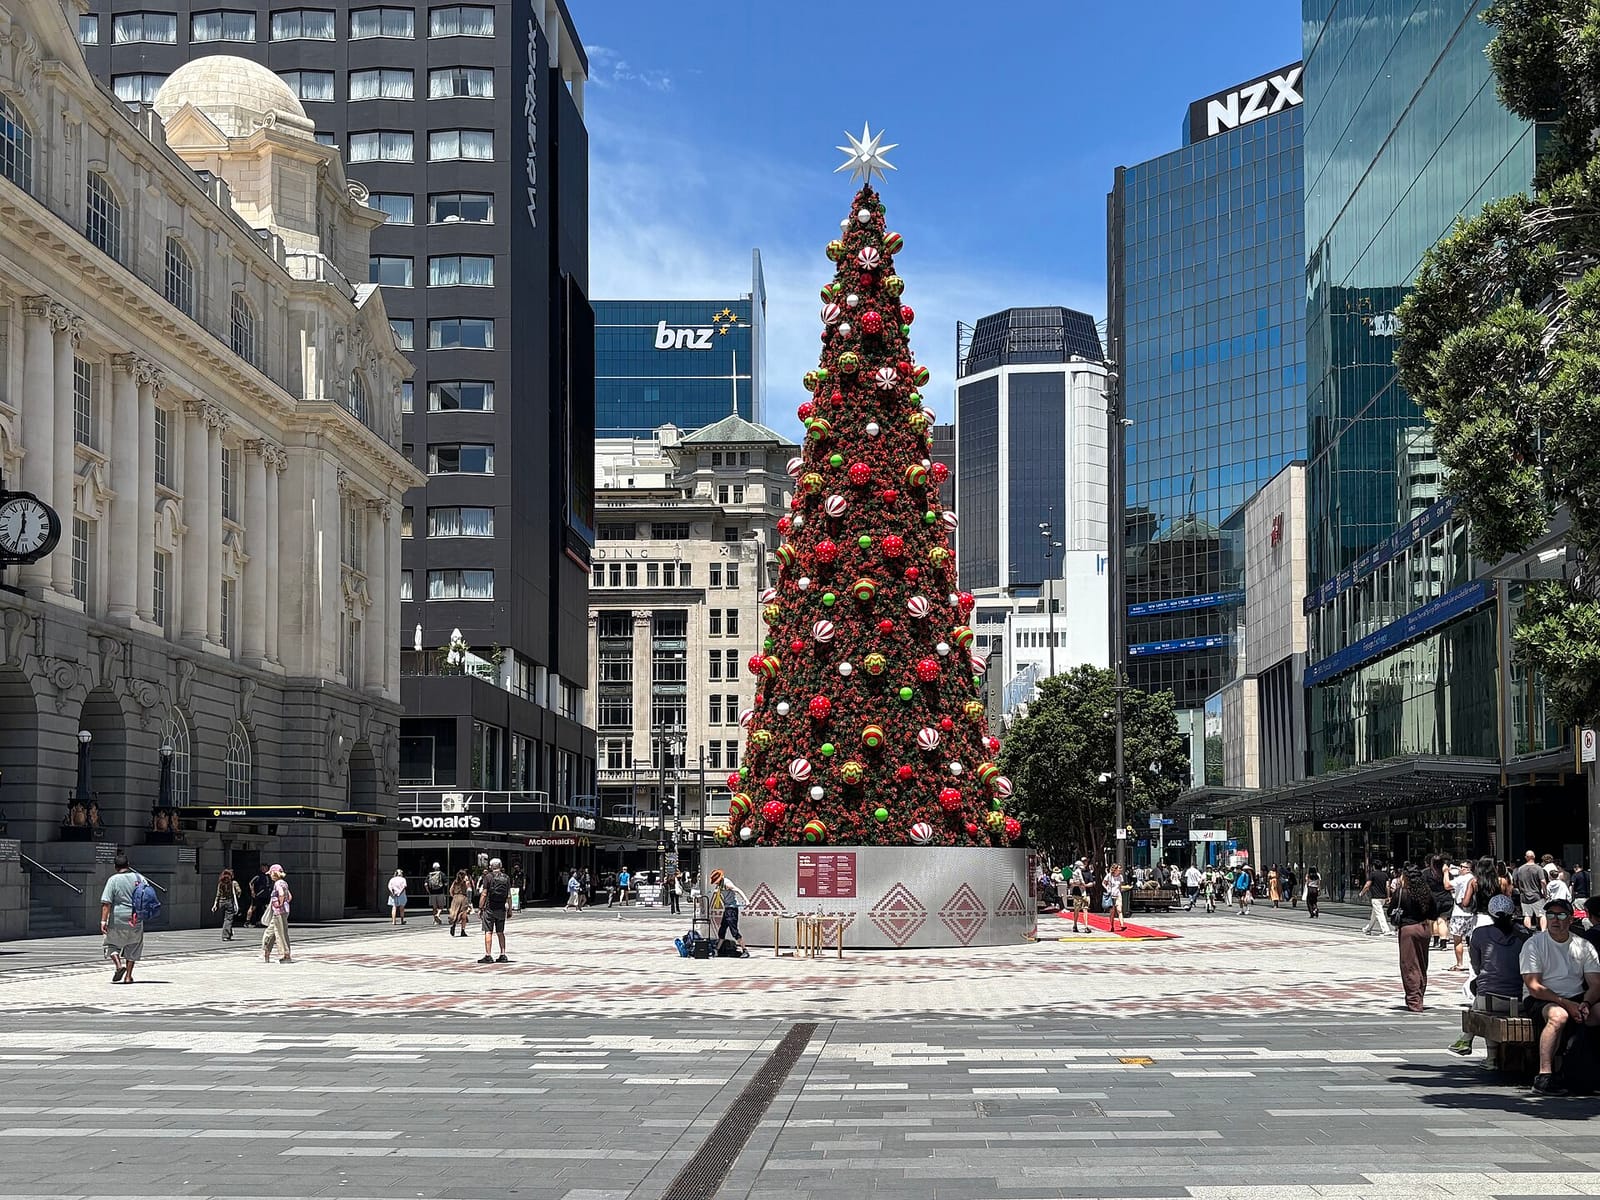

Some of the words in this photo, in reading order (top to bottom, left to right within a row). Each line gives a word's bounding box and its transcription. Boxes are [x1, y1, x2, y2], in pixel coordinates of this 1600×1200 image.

[1207, 67, 1304, 136] NZX
[654, 320, 714, 349] bnz
[599, 549, 648, 559] DING
[396, 815, 481, 828] Donald's
[528, 838, 576, 846] McDonald's
